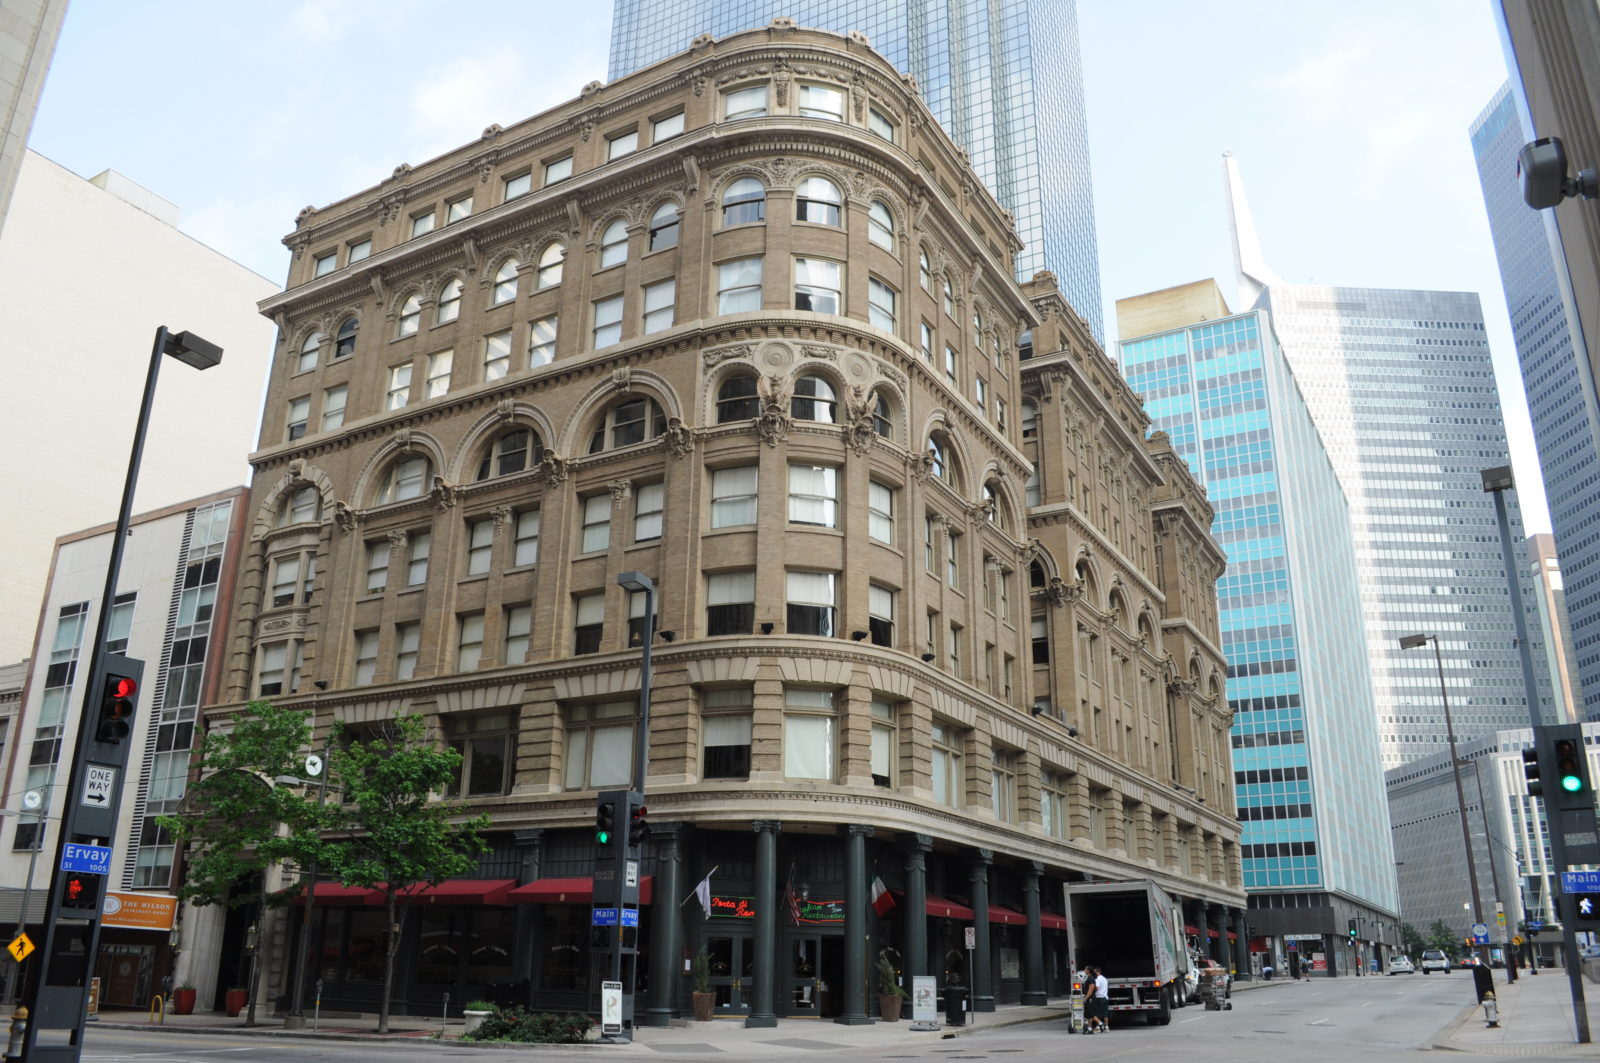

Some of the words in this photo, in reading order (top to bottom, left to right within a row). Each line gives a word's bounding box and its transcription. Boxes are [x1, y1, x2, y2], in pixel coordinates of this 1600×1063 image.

[90, 770, 111, 781] ONE
[89, 781, 110, 792] WAY
[65, 846, 109, 864] Ervay
[63, 861, 72, 869] St
[1567, 873, 1598, 883] Main
[711, 897, 737, 908] Porta
[738, 900, 748, 909] di
[595, 910, 615, 918] Main
[622, 910, 638, 921] Ervay
[735, 907, 756, 917] Rom
